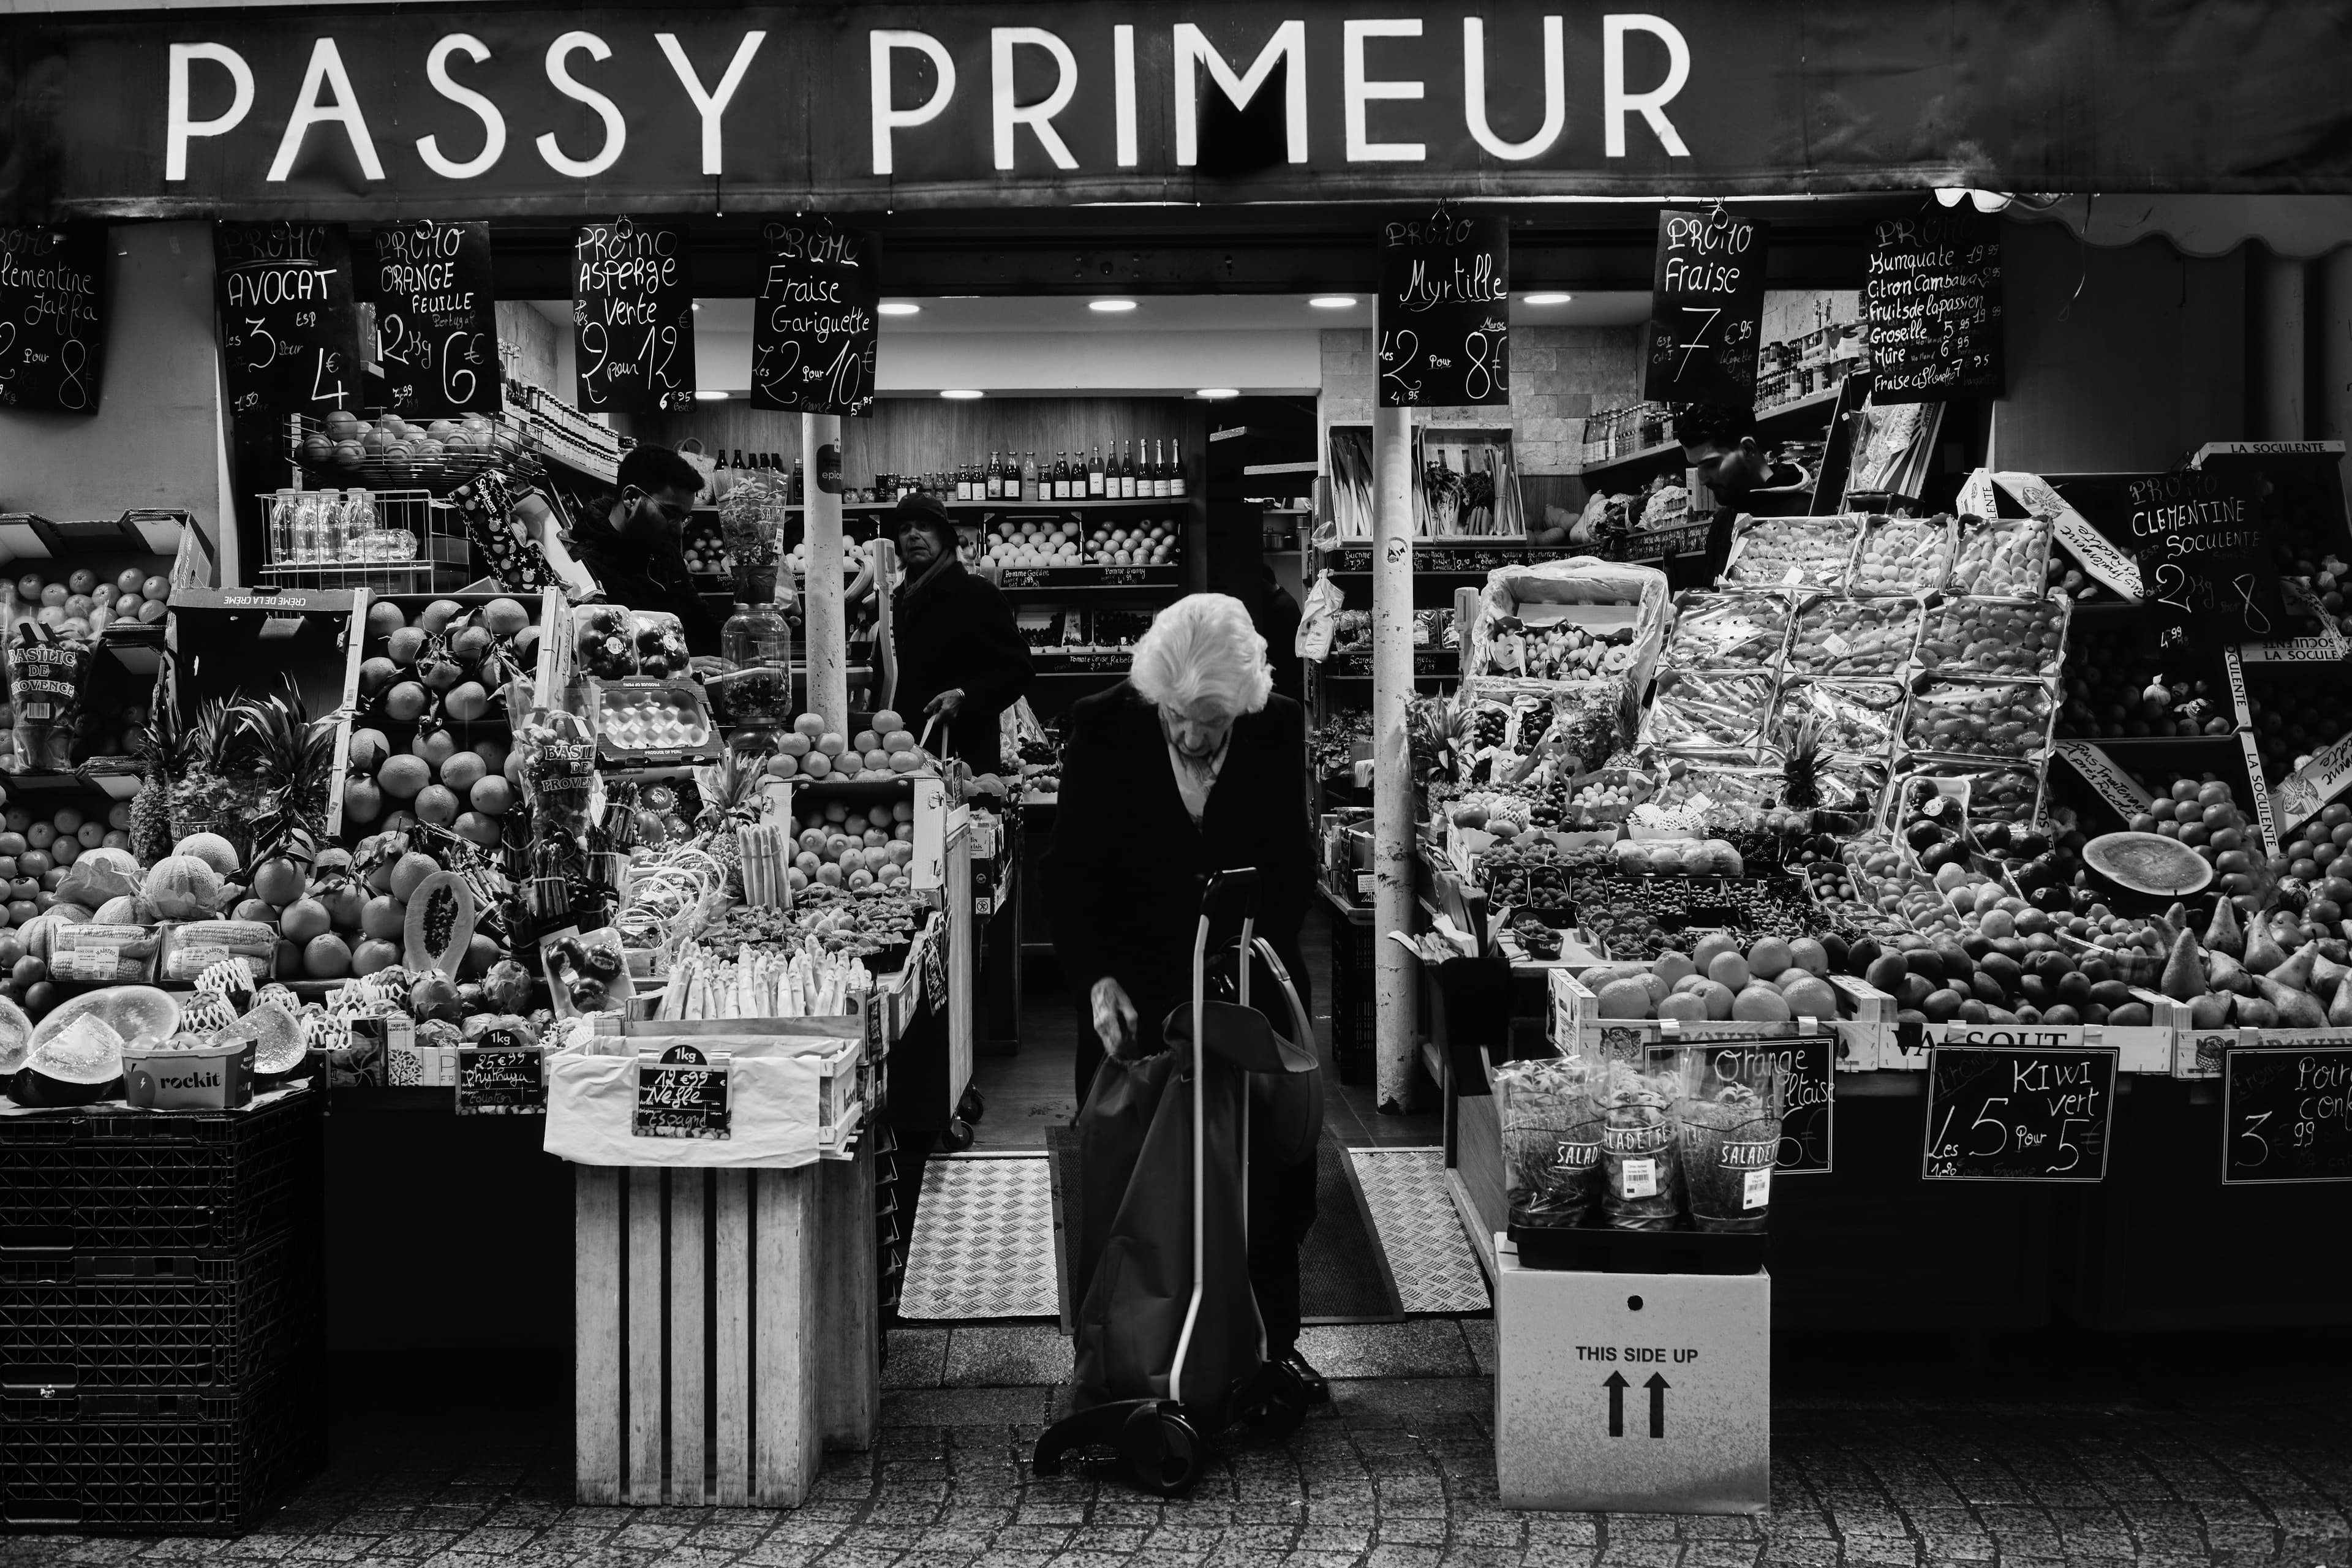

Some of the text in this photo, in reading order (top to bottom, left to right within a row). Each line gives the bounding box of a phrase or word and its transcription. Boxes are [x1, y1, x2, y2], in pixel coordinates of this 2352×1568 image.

[165, 13, 1692, 181] PASSY PRIMEUR
[1667, 217, 1754, 255] PROMO
[1, 252, 94, 294] lémentine
[1869, 244, 1954, 277] Kumquate
[228, 269, 337, 307] AVOCAT
[382, 262, 454, 295] ORANGE
[760, 265, 842, 303] Fraise
[1400, 253, 1507, 312] Myrtille
[1665, 257, 1740, 293] Fraise
[1868, 279, 1912, 298] Citron
[412, 292, 475, 314] FEUILLE
[772, 304, 870, 344] Gariguette
[1479, 317, 1507, 331] Maroc
[1871, 318, 1928, 344] Groseille
[23, 348, 49, 363] Pour
[245, 317, 276, 372] 3
[1875, 346, 1906, 368] Mûre
[761, 340, 801, 404] 2
[802, 366, 824, 382] Pour
[1382, 330, 1422, 390] 2
[1428, 354, 1452, 369] Pour
[1874, 374, 1910, 392] Fraise
[2231, 442, 2326, 453] LA SOCULENTE
[1983, 487, 1997, 519] LENTE
[2133, 496, 2247, 537] CLEMENTINE
[2166, 530, 2260, 560] SOCULENTE
[1005, 569, 1049, 578] Pomme Golden
[253, 597, 264, 605] LA
[265, 597, 276, 605] DE
[2156, 563, 2192, 613] 2
[8, 647, 77, 667] BASILIC
[2264, 650, 2341, 660] LA SOCULE
[28, 665, 50, 677] DE
[2226, 643, 2247, 707] OCULENTE
[11, 679, 75, 698] PROVENCE
[544, 744, 593, 760] BASIL
[570, 761, 590, 774] DE
[541, 777, 592, 792] PROVEN
[2097, 764, 2153, 816] Traitemen
[2247, 753, 2277, 848] LA SOCULENTE
[491, 1031, 511, 1045] 1kg
[674, 1046, 696, 1063] 1kg
[160, 1072, 221, 1089] rockit
[2013, 1060, 2092, 1093] KIWI
[2294, 1055, 2352, 1091] Poir
[1928, 1104, 1959, 1159] Les
[1969, 1097, 2009, 1156] 5
[2015, 1125, 2048, 1153] Pour
[1721, 1142, 1777, 1164] SALADET
[1575, 1346, 1699, 1364] THIS SIDE UP
